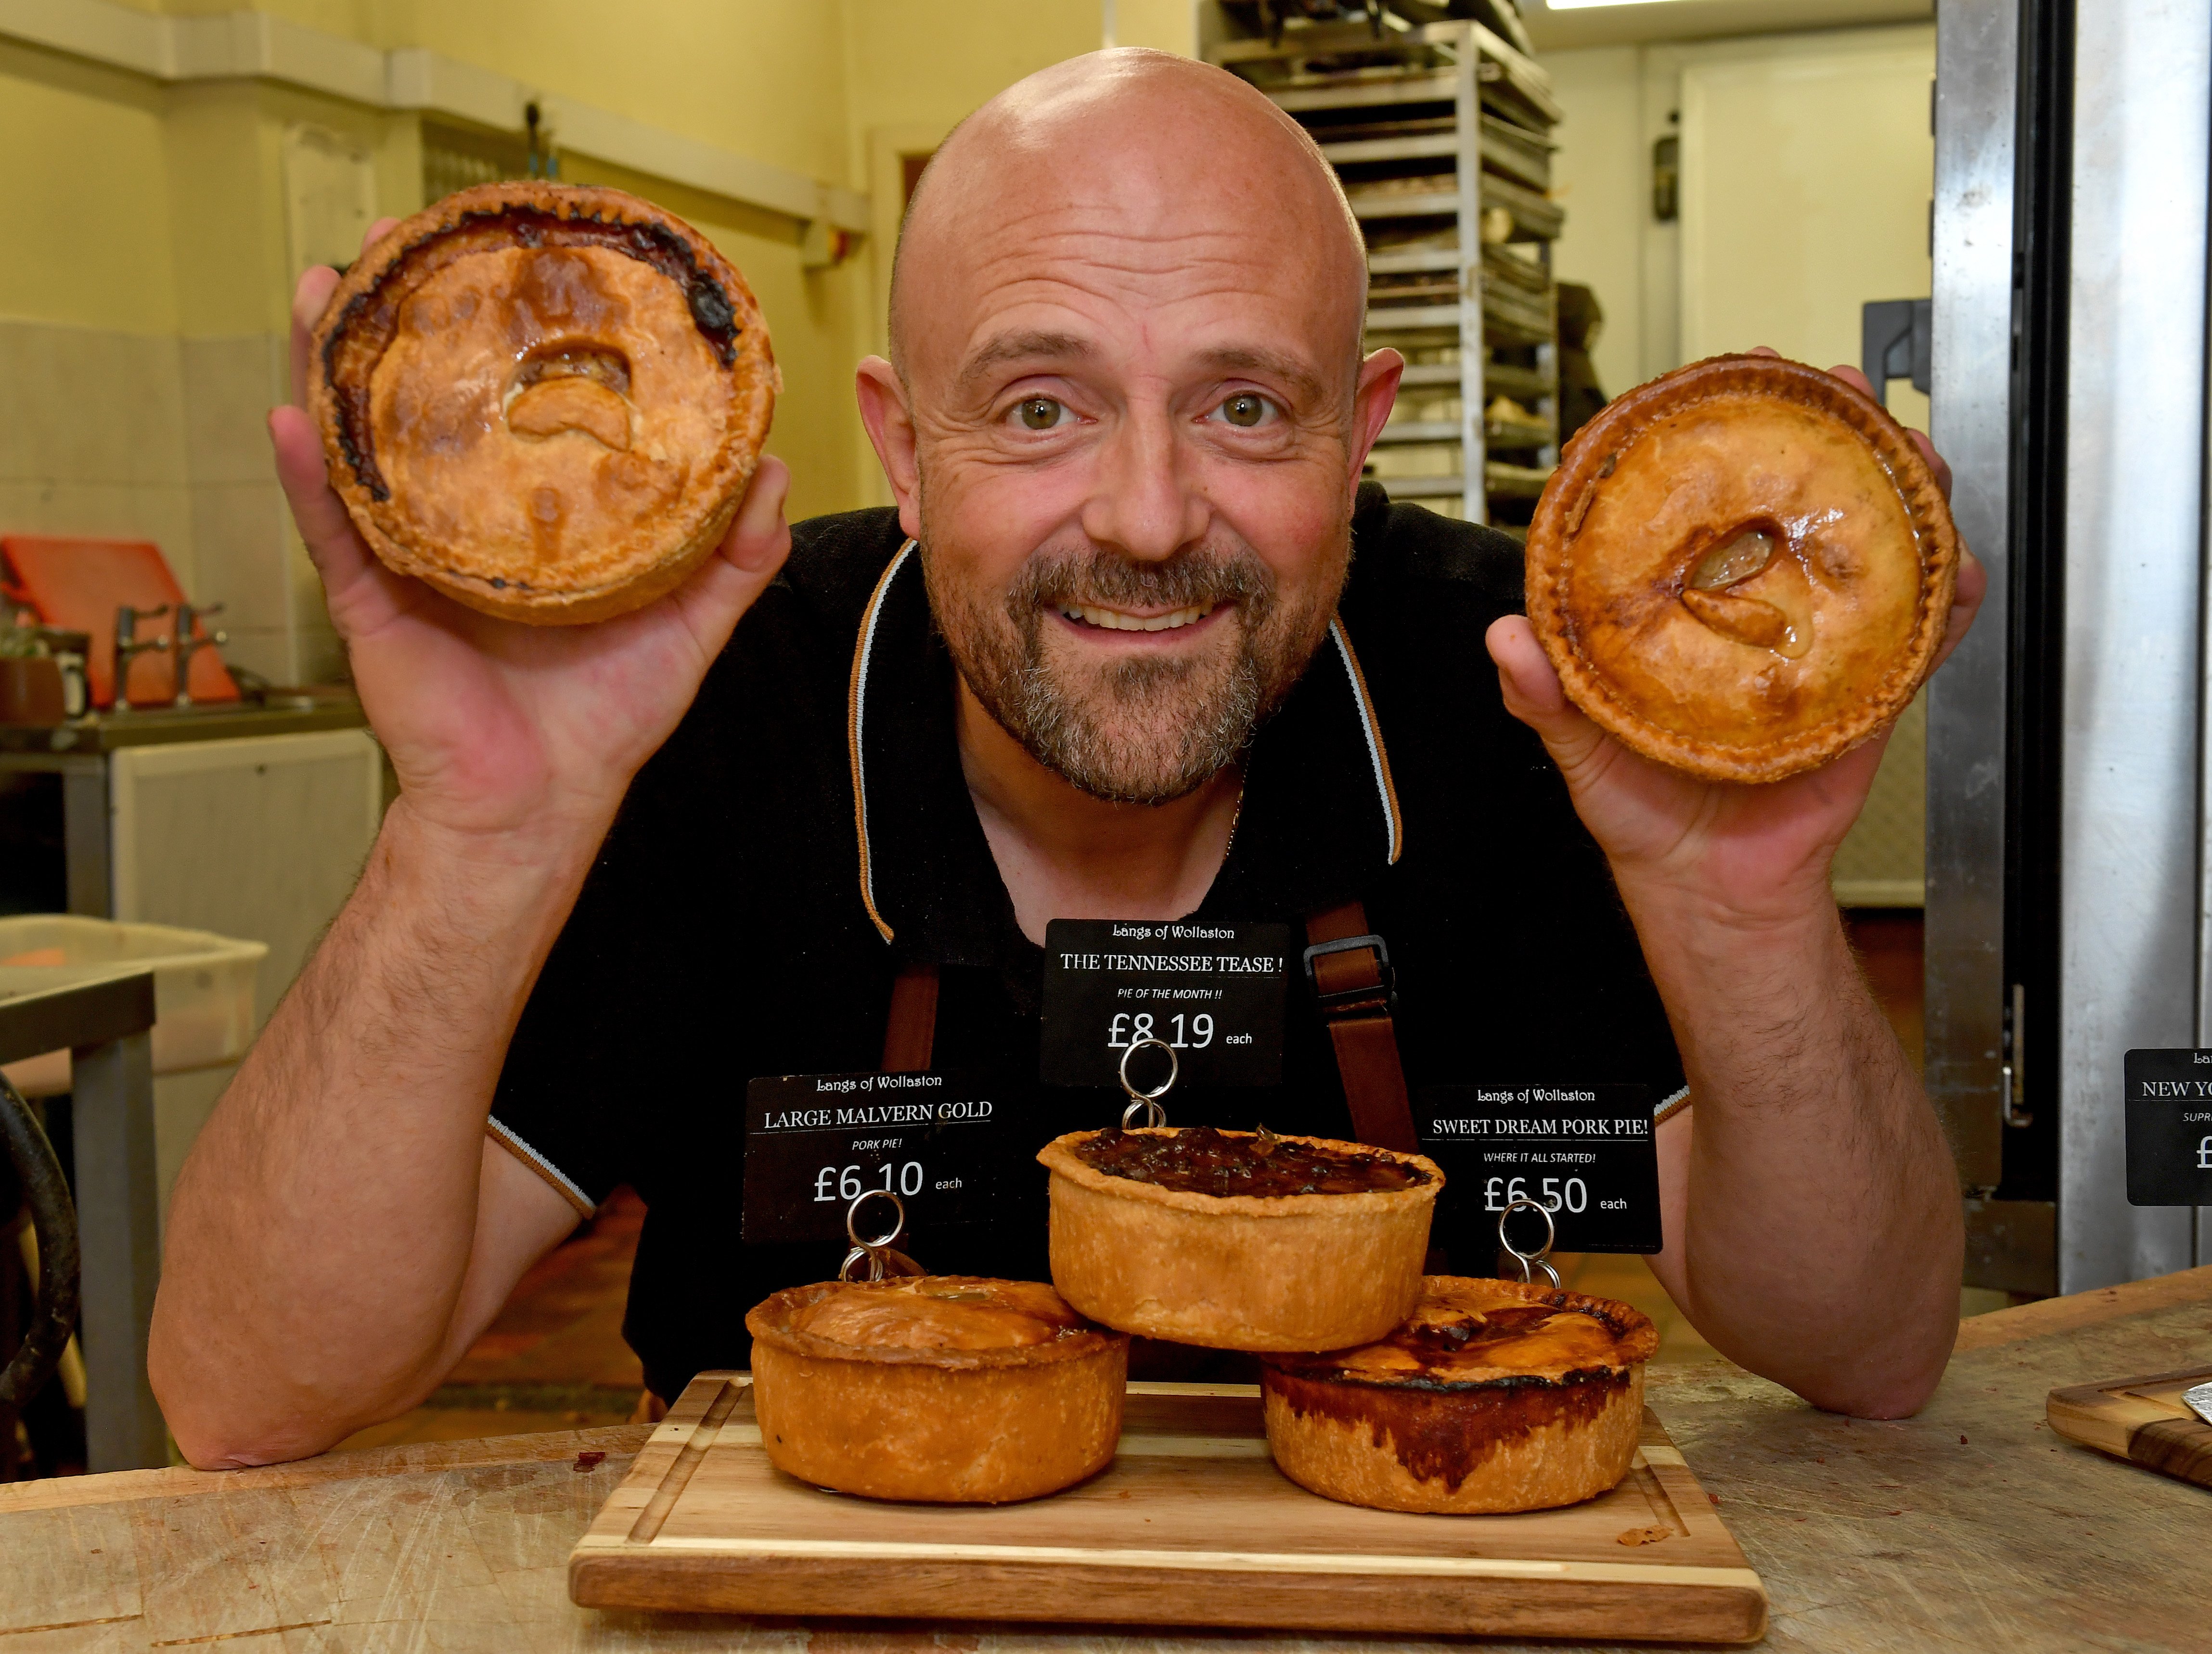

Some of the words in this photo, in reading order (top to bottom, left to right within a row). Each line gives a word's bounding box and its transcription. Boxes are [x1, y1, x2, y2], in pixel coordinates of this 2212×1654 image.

[1112, 924, 1151, 940] Langs
[1155, 926, 1168, 940] of
[1171, 925, 1235, 939] Wollaston
[1060, 954, 1100, 969] THE
[1104, 955, 1213, 971] TENNESSEE
[1216, 956, 1274, 972] TEASE
[1118, 988, 1133, 998] PIE
[1135, 989, 1150, 998] OF
[1152, 989, 1171, 999] THE
[1172, 989, 1212, 999] MONTH
[1226, 1033, 1252, 1044] each
[816, 1079, 857, 1093] Langs
[860, 1077, 874, 1092] of
[877, 1075, 942, 1089] Wollaston
[2142, 1082, 2191, 1096] NEW
[1477, 1089, 1514, 1104] Langs
[1517, 1089, 1530, 1104] of
[1532, 1088, 1595, 1101] Wollaston
[764, 1110, 831, 1128] LARGE
[836, 1104, 934, 1125] MALVERN
[938, 1101, 992, 1119] GOLD
[1433, 1119, 1491, 1134] SWEET
[1494, 1119, 1557, 1134] DREAM
[1561, 1119, 1611, 1135] PORK
[1613, 1119, 1648, 1135] PIE!
[852, 1139, 880, 1150] PORK
[882, 1138, 902, 1149] PIE!
[1484, 1152, 1518, 1162] WHERE
[1520, 1153, 1529, 1162] IT
[1531, 1153, 1548, 1163] ALL
[1550, 1153, 1595, 1163] STARTED!
[813, 1162, 923, 1202] £610
[935, 1177, 962, 1189] each
[1600, 1198, 1627, 1209] each
